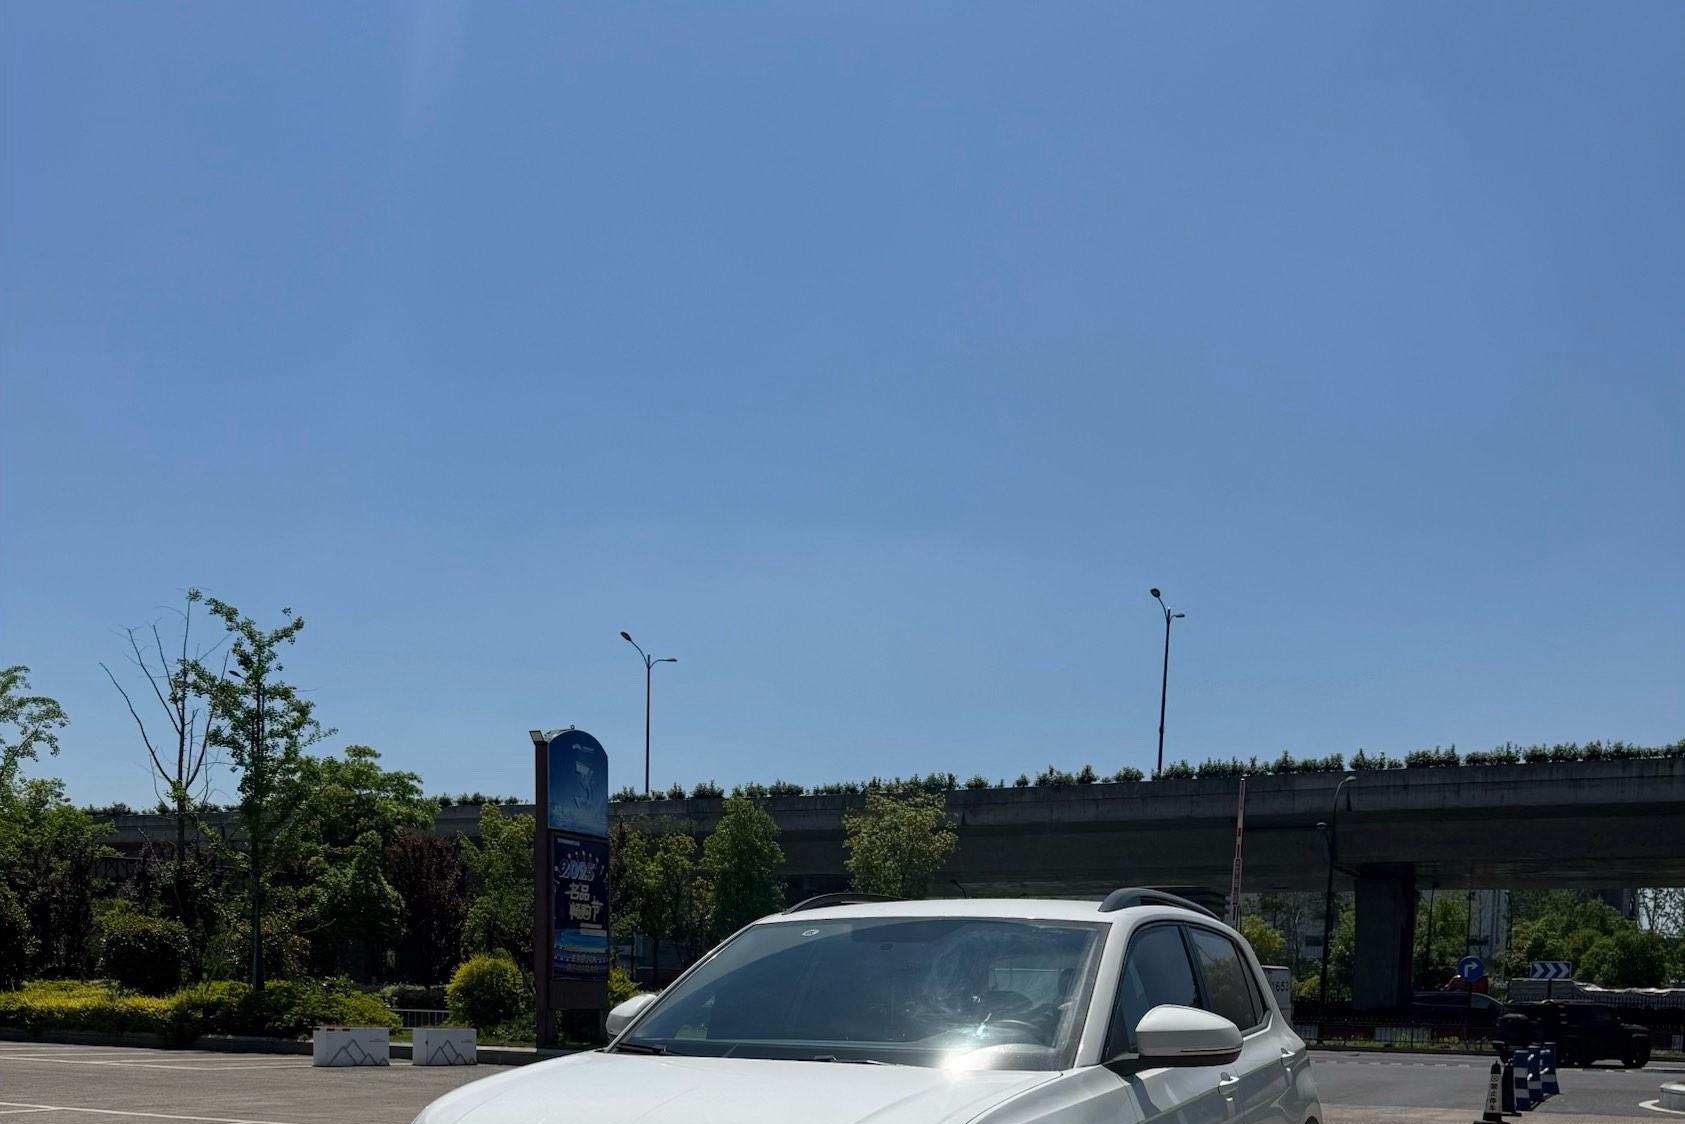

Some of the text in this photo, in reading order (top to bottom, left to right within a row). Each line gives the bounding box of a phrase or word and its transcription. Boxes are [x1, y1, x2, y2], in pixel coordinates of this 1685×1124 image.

[559, 858, 595, 882] 2025
[565, 882, 590, 901] 名品
[569, 895, 604, 922] 畅购节
